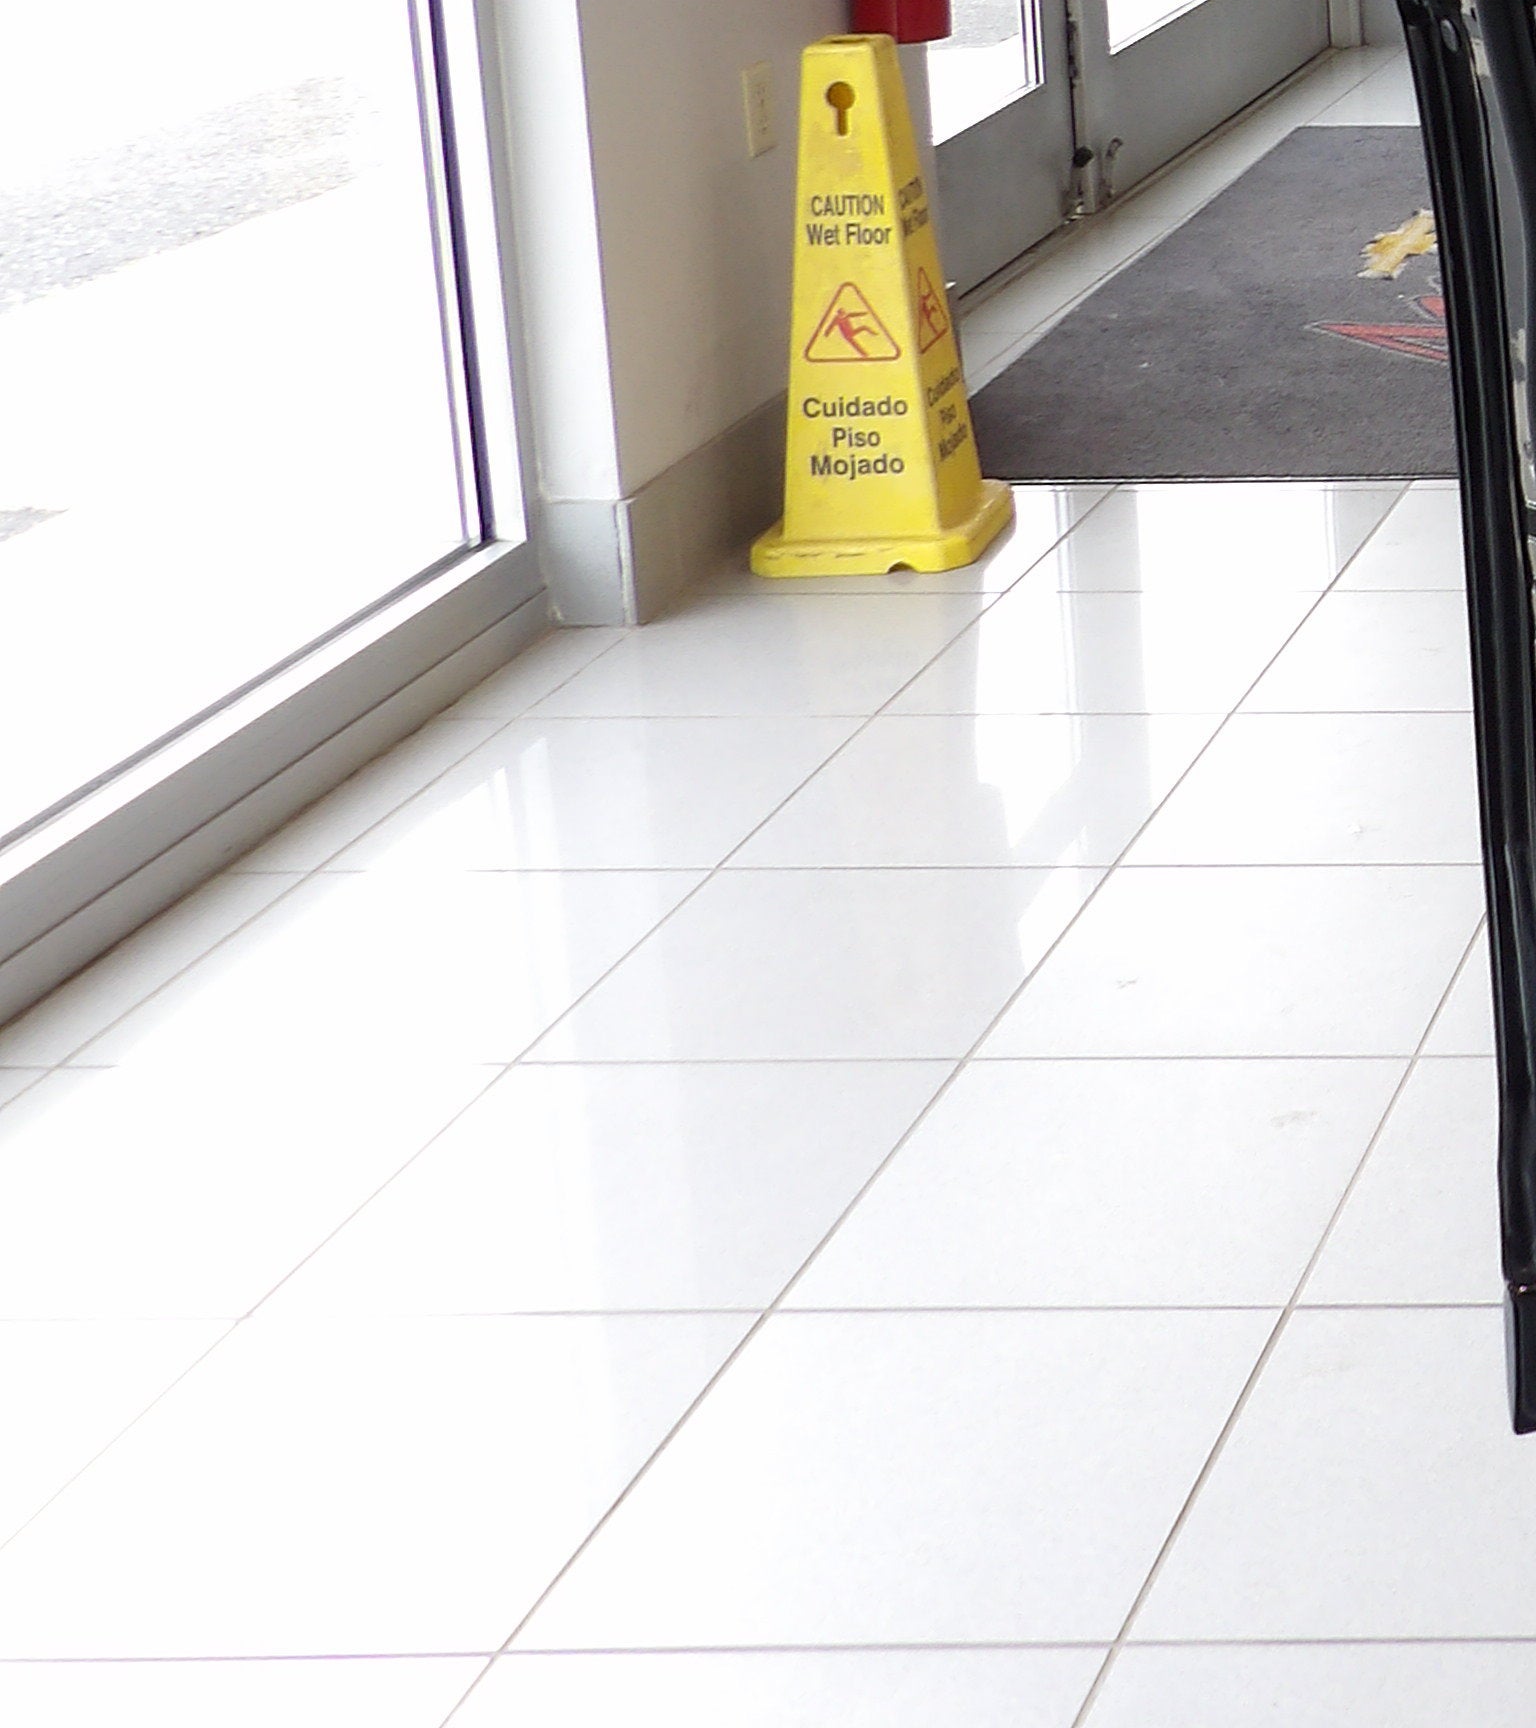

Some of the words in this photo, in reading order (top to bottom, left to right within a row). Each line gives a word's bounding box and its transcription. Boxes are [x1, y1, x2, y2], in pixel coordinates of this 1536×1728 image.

[811, 194, 885, 216] CAUTION
[806, 222, 841, 246] Wet
[845, 222, 892, 245] Floor
[802, 395, 908, 418] Cuidado
[832, 426, 881, 447] Piso
[810, 453, 905, 480] Mojado
